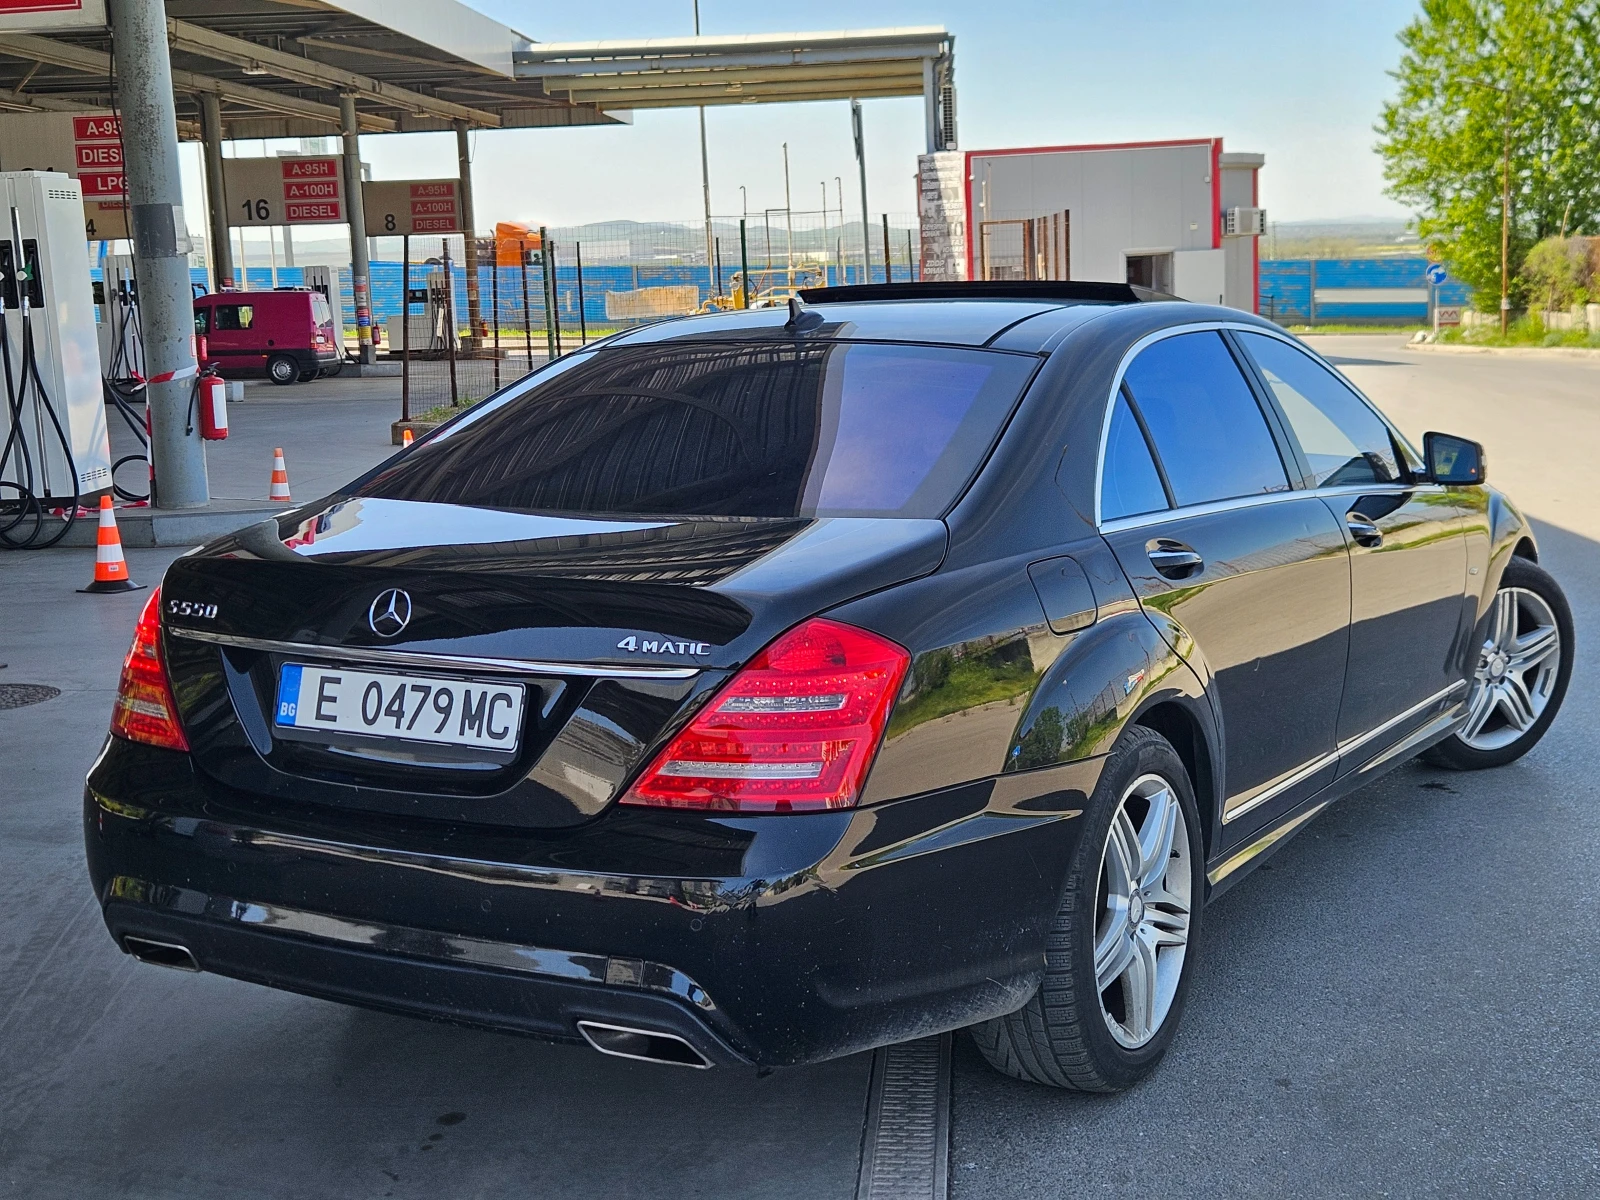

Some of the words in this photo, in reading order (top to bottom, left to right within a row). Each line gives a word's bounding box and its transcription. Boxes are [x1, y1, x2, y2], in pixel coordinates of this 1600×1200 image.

[86, 121, 121, 135] A-95
[82, 148, 123, 163] DIES
[292, 163, 328, 175] A-95H
[290, 184, 334, 196] A-100H
[417, 185, 447, 195] A-95H
[242, 199, 270, 220] 16
[290, 206, 335, 217] DIESEL
[415, 202, 452, 212] A-100H
[385, 214, 396, 231] 8
[416, 219, 452, 229] DIESEL
[167, 600, 218, 619] S550
[314, 675, 342, 723] E
[280, 702, 296, 717] BG
